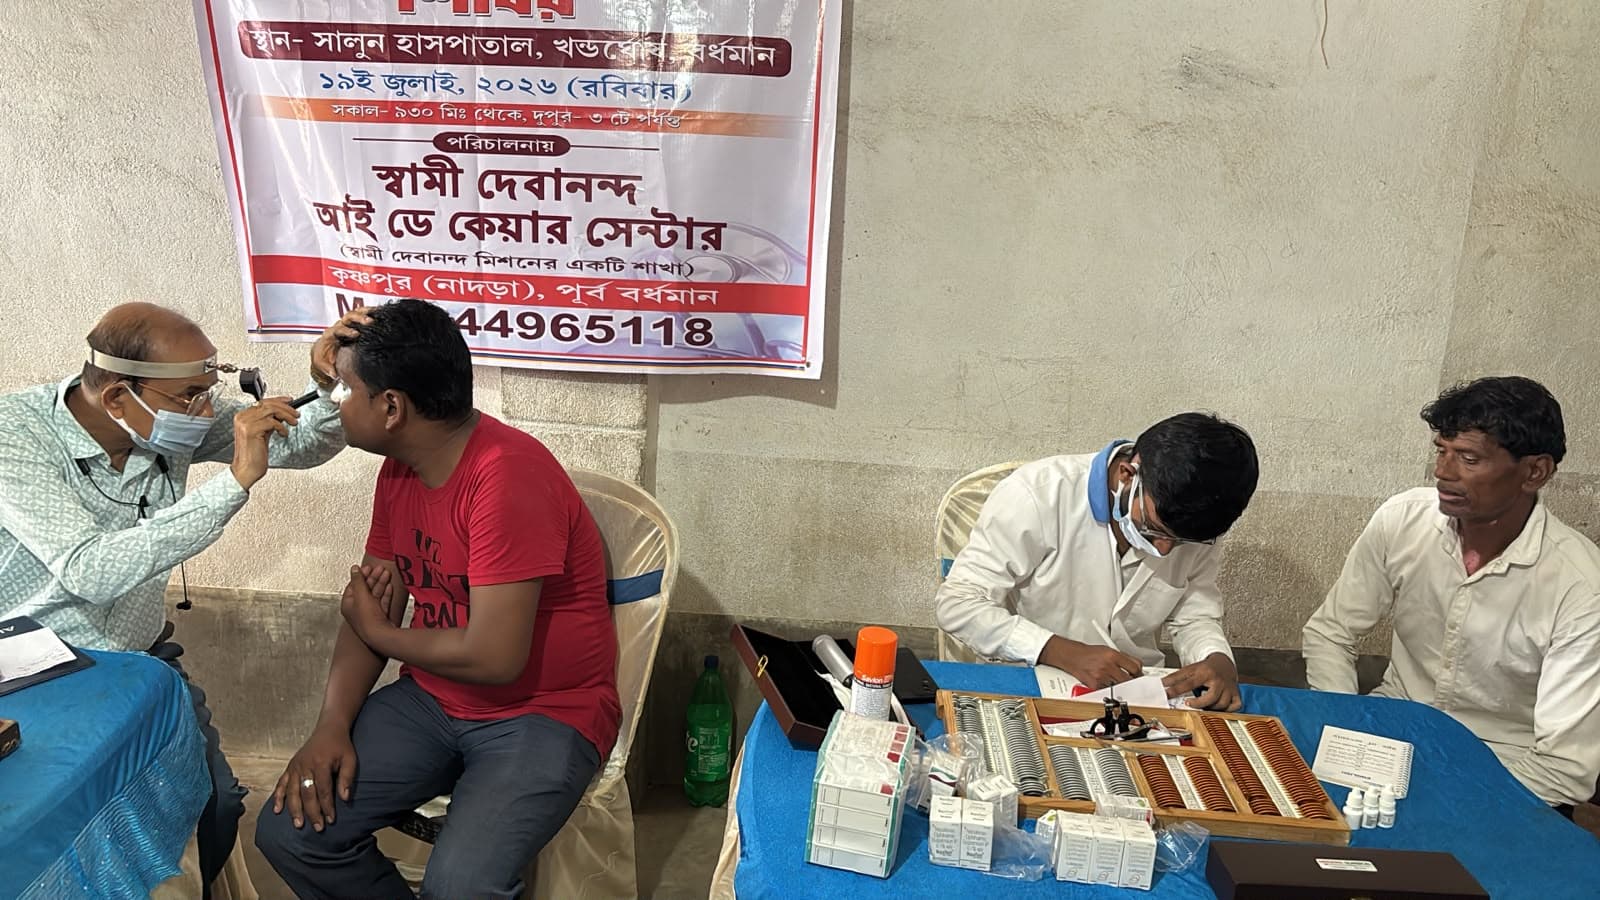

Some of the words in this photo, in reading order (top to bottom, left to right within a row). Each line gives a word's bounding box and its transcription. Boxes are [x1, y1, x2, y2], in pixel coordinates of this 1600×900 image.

[249, 30, 303, 57] স্থান-
[312, 30, 385, 59] সালুন
[392, 31, 543, 60] হাসপাতাল,
[687, 37, 776, 67] বর্ধমান
[320, 67, 375, 93] ১৯ই
[381, 70, 465, 98] জুলাই,
[478, 76, 557, 94] ২০২৬
[567, 74, 692, 103] (রবিবার)
[332, 103, 388, 118] সকাল-
[474, 107, 527, 122] থেকে,
[588, 112, 603, 124] ৩
[610, 109, 631, 126] টে
[636, 111, 681, 128] পর্যন্ত
[446, 133, 554, 153] পরিচালনায়
[372, 154, 464, 198] স্বামী
[478, 167, 642, 205] দেবানন্দ
[313, 193, 378, 242] আই
[388, 208, 435, 239] ডে
[449, 210, 572, 244] কেয়ার
[587, 207, 727, 250] সেন্টার
[340, 243, 384, 262] (স্বামী
[392, 250, 468, 267] দেবানন্দ
[474, 250, 557, 270] মিশনের
[566, 256, 626, 273] একটি
[631, 261, 694, 279] শাখা)
[328, 265, 412, 295] কৃষ্ণপুর
[423, 274, 545, 301] (নাদড়া),
[556, 281, 615, 306] পূর্ব
[616, 283, 719, 305] বর্ধমান
[455, 307, 714, 347] 44965118
